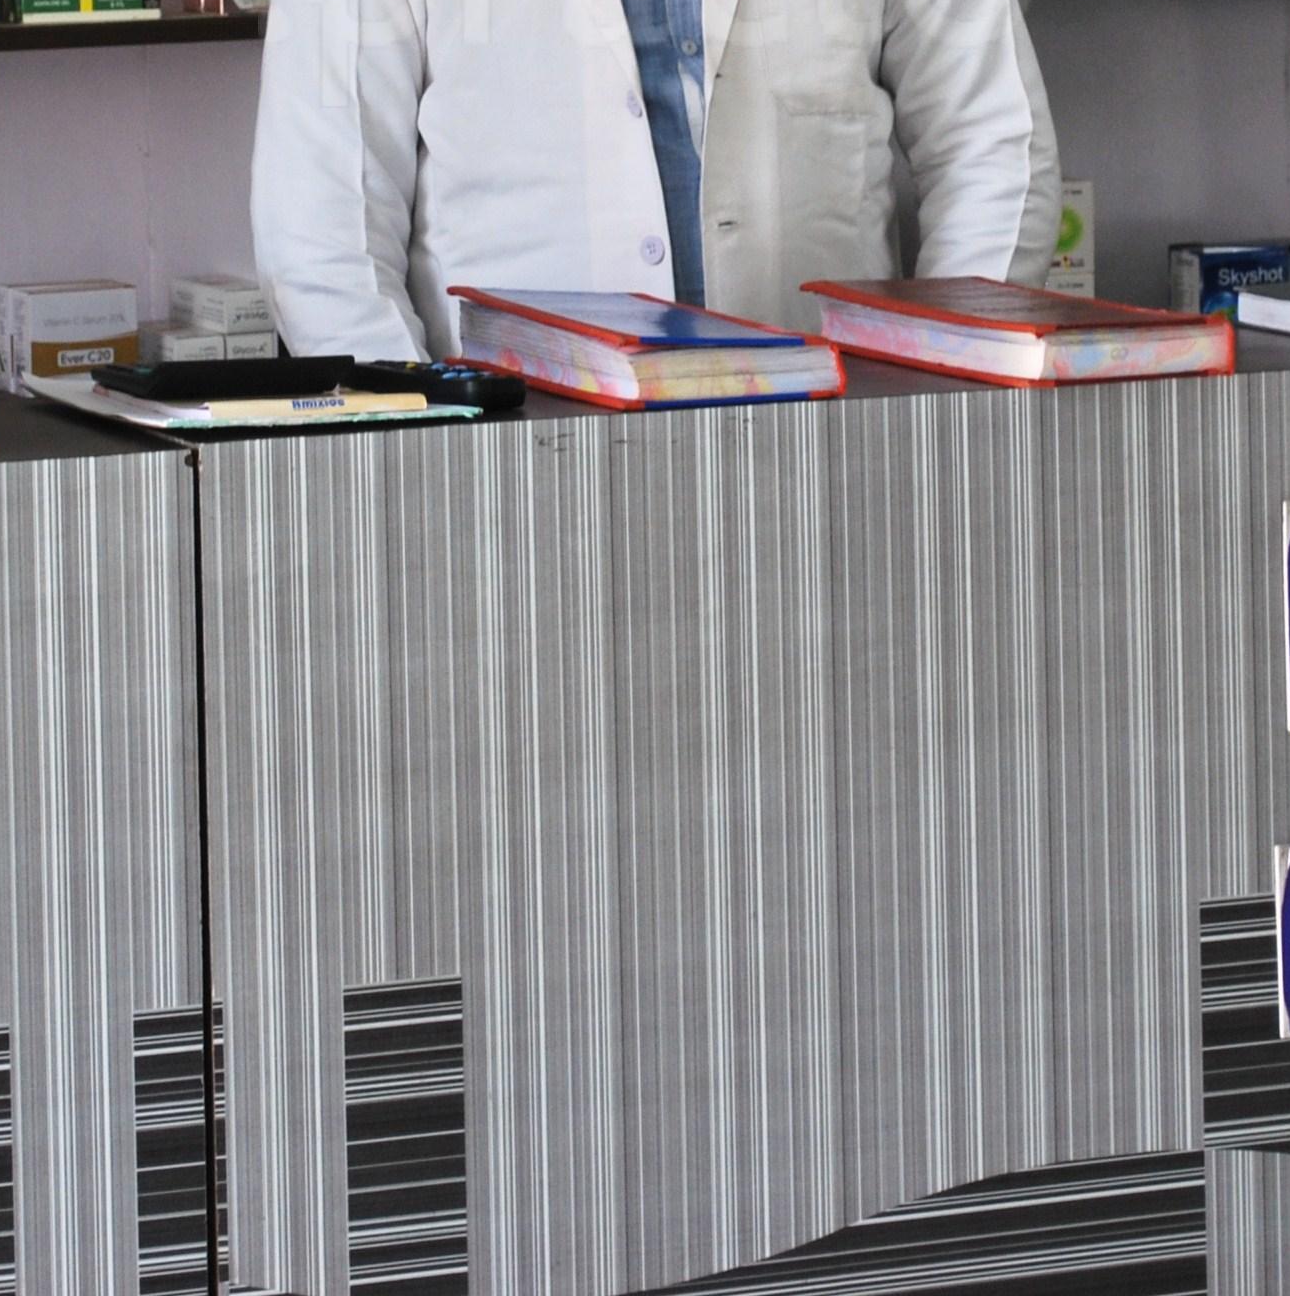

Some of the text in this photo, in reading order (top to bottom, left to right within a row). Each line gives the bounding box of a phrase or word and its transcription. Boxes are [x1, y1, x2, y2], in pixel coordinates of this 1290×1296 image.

[1218, 266, 1285, 289] Skyshot
[60, 349, 112, 365] Ever C20
